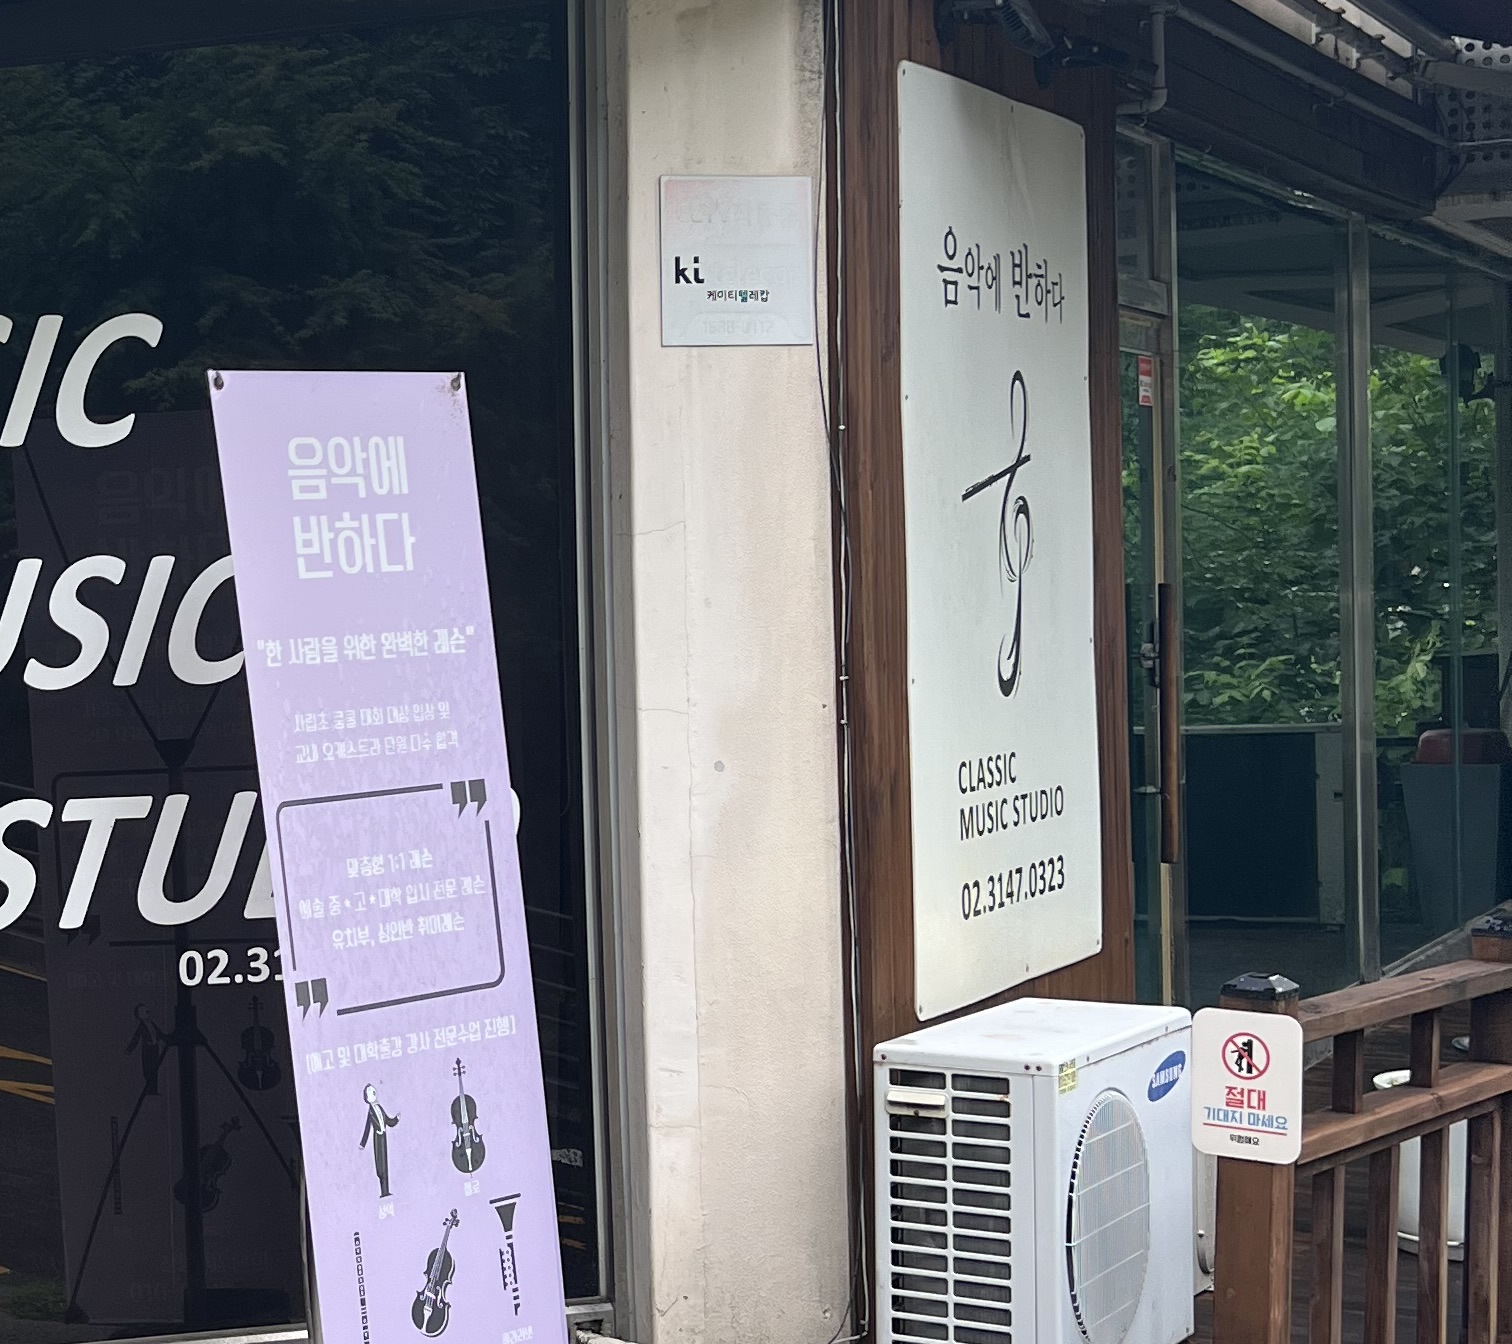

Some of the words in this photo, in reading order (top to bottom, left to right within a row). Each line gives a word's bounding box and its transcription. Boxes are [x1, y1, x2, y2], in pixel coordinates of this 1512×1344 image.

[937, 226, 1001, 314] 음악에
[1010, 242, 1065, 324] 반하다
[288, 436, 409, 501] 음악에
[292, 512, 417, 580] 반하다
[288, 636, 338, 664] 사람을
[343, 633, 377, 661] 위한
[381, 629, 429, 658] 완벽한
[958, 751, 1017, 794] CLASSIC
[959, 797, 1008, 841] MUSIC
[1013, 785, 1064, 827] STUDIO
[961, 854, 1065, 920] 02.3147.0323
[1203, 1106, 1243, 1125] 기대지
[1247, 1112, 1288, 1131] 마세요
[1225, 1085, 1266, 1111] 절대
